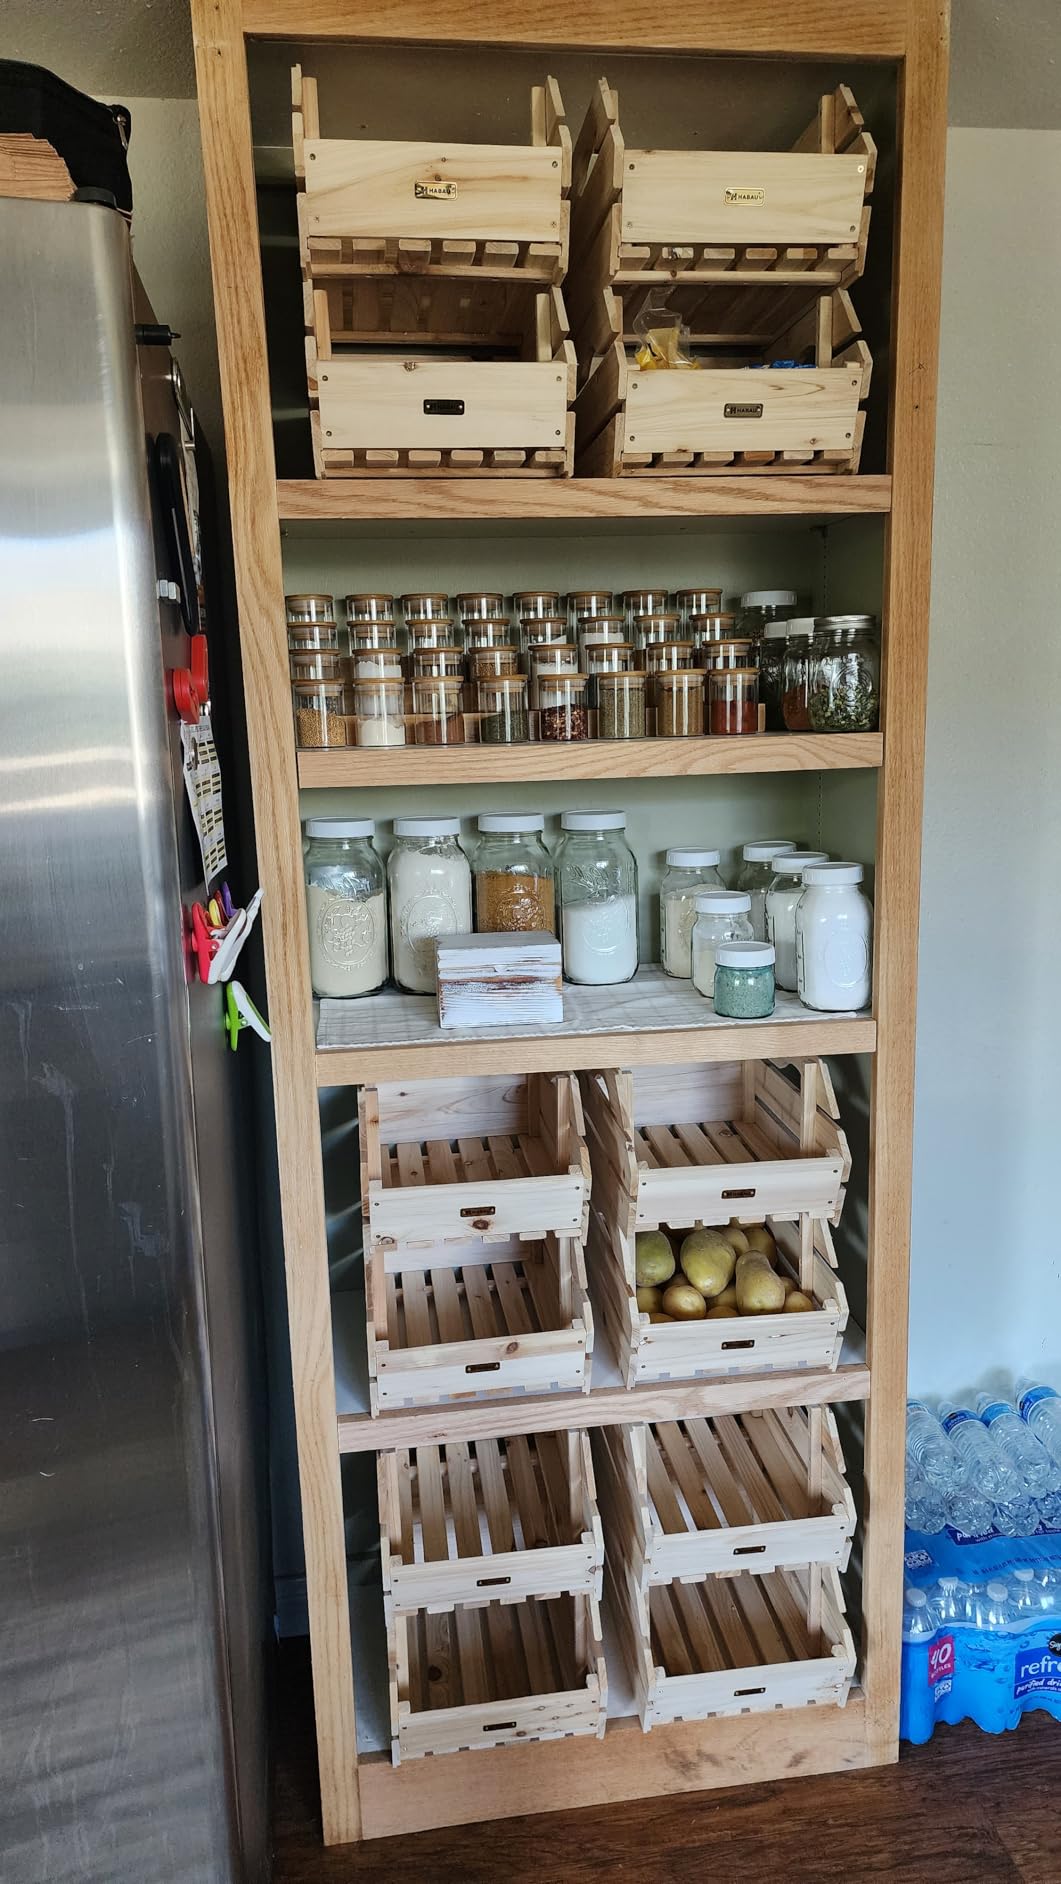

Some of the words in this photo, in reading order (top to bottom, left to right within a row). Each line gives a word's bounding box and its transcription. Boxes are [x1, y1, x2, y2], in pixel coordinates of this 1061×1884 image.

[738, 193, 759, 201] HABAU
[956, 1526, 994, 1541] puied
[931, 1643, 952, 1669] 40
[1016, 1678, 1046, 1696] purified
[1047, 1678, 1061, 1687] dri
